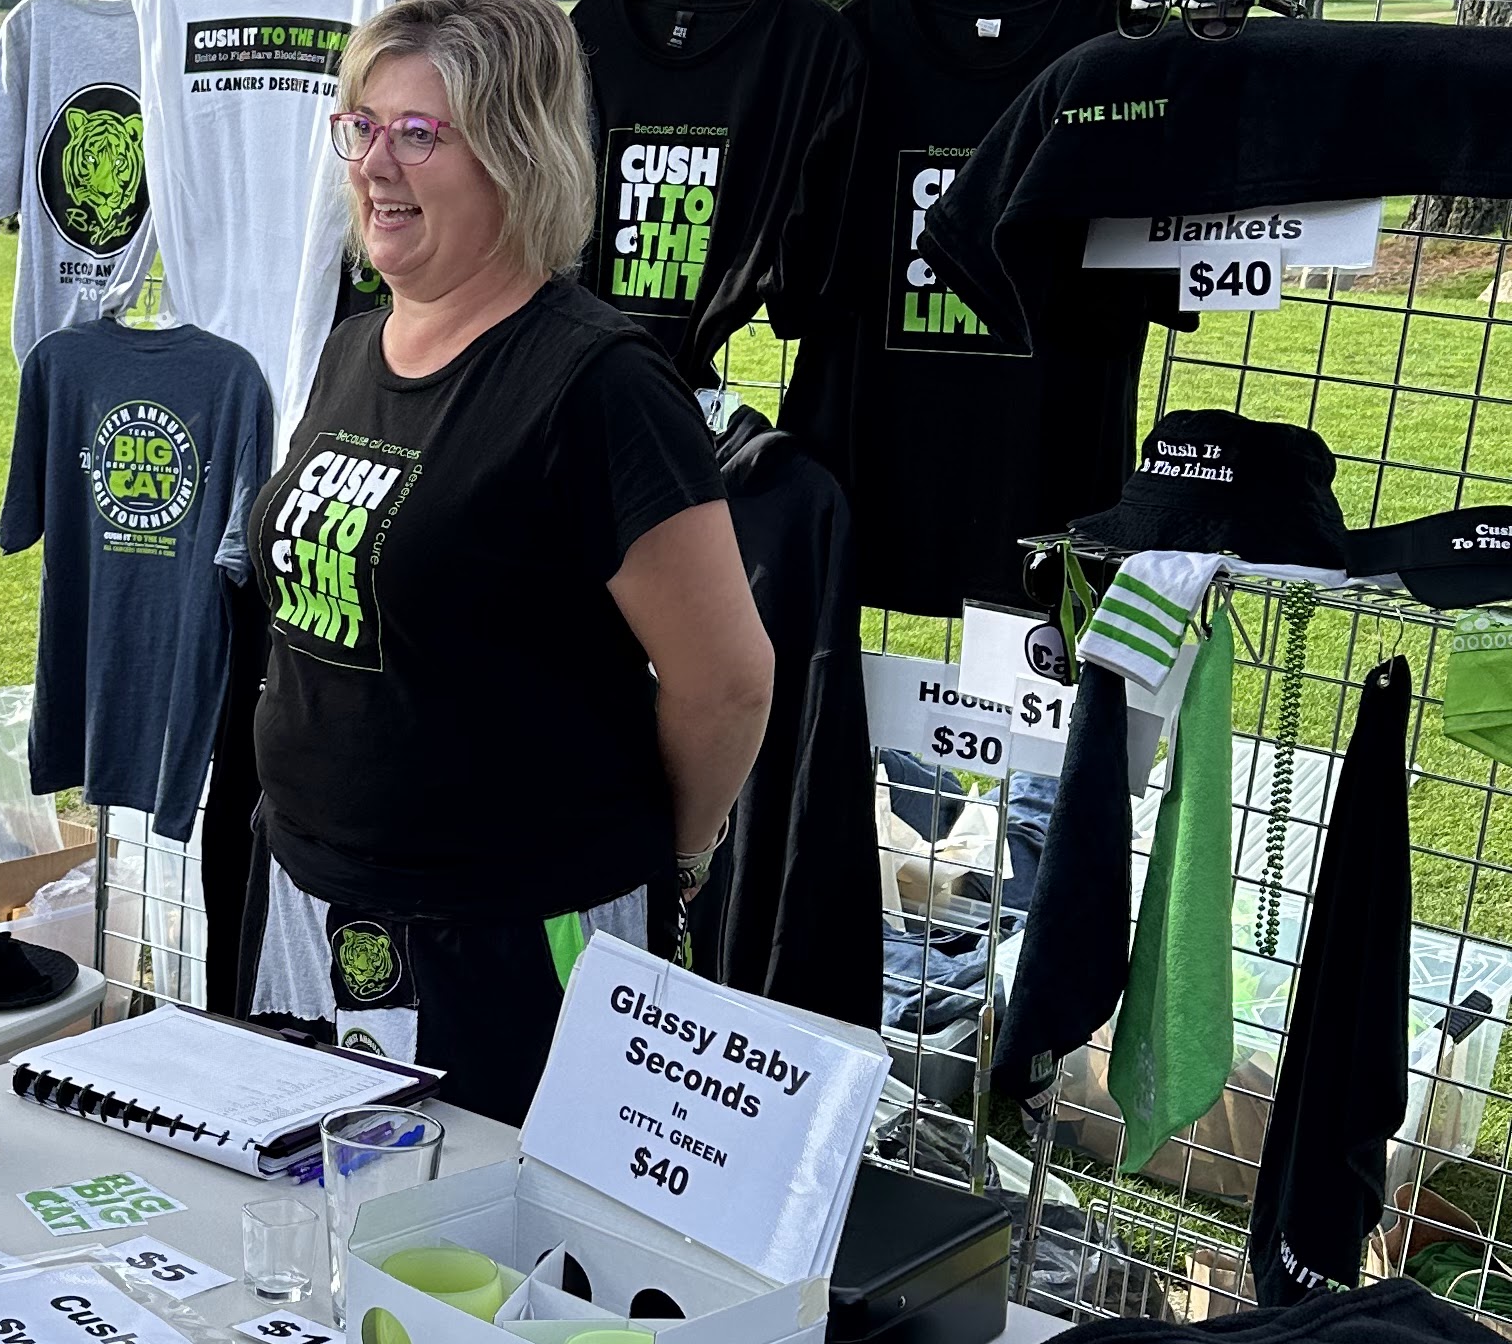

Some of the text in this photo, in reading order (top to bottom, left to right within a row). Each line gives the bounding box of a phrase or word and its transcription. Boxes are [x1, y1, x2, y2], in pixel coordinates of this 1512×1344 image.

[194, 27, 313, 49] CUSH IT TO THE
[191, 79, 211, 93] ALL
[634, 123, 674, 135] Because
[1062, 98, 1169, 124] THE LIMIT
[621, 144, 720, 186] CUSH
[619, 183, 714, 224] IT TO
[640, 222, 710, 263] THE
[1148, 213, 1303, 242] Blankets
[612, 258, 705, 301] LIMIT
[1189, 260, 1272, 301] $40
[98, 406, 190, 452] FIFTH ANNUAL
[129, 428, 156, 437] TEAM
[1157, 440, 1222, 459] Cush It
[114, 435, 173, 465] BIG
[109, 470, 176, 499] CAT
[298, 450, 402, 510] CUSH
[388, 464, 424, 516] deserve
[1151, 460, 1234, 483] The Limit
[109, 477, 193, 528] TOURNAMENT
[275, 488, 369, 554] IT TO
[381, 518, 392, 530] a
[1451, 537, 1511, 550] To The
[370, 532, 387, 566] cure
[295, 538, 360, 605] THE
[275, 575, 364, 649] LIMIT
[931, 725, 1003, 765] $30
[610, 984, 812, 1096] Glassy Baby
[625, 1036, 762, 1118] Seconds
[619, 1105, 728, 1168] CITTL GREEN
[629, 1146, 690, 1197] $40
[24, 1190, 93, 1232] CAT
[72, 1183, 144, 1225] BIG
[125, 1251, 198, 1282] $5
[1296, 1266, 1325, 1289] IT
